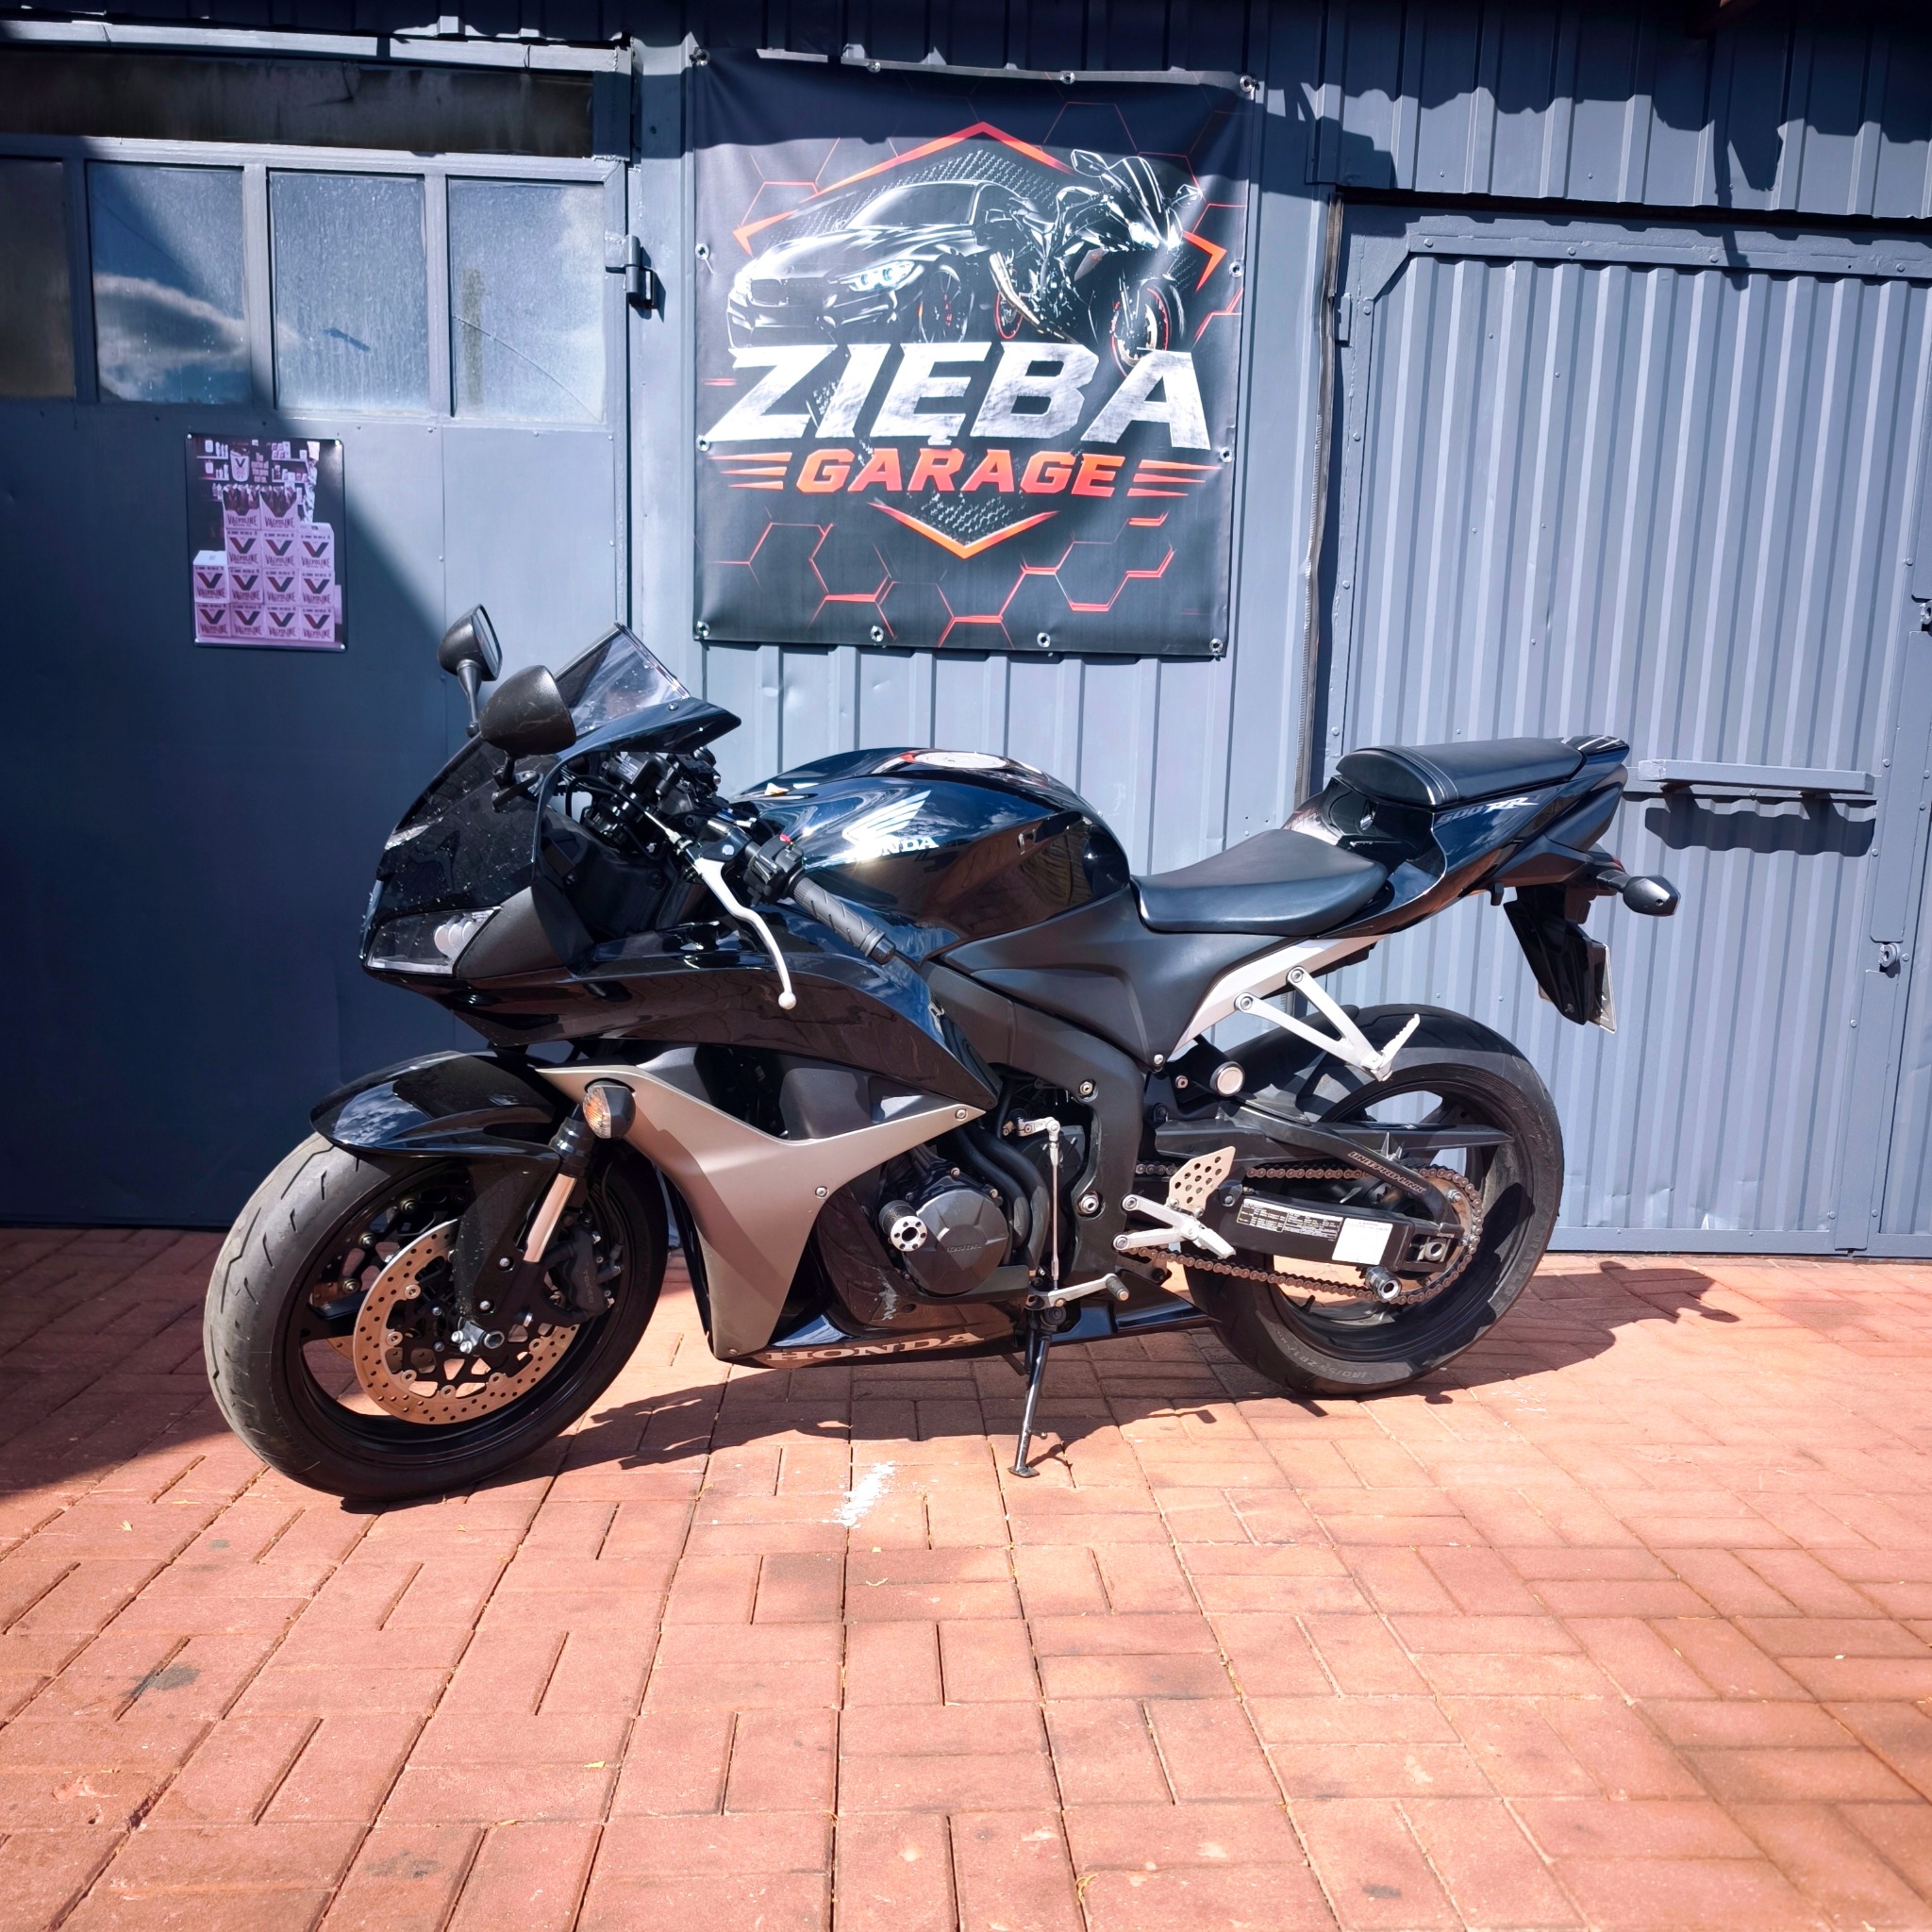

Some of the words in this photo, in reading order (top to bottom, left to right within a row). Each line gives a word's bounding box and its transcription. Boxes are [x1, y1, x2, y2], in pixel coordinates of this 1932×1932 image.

[708, 341, 1211, 451] ZIĘBA
[795, 448, 1126, 497] GARAGE
[227, 515, 257, 526] VALVOLINE
[265, 517, 294, 528] VALVOLINE
[229, 554, 258, 564] VALVOLINE
[266, 557, 295, 566] VALVOLINE
[301, 558, 330, 567] VALVOLINE
[846, 836, 940, 863] NDA
[1347, 1151, 1376, 1168] UNIT
[766, 1332, 985, 1361] HONDA
